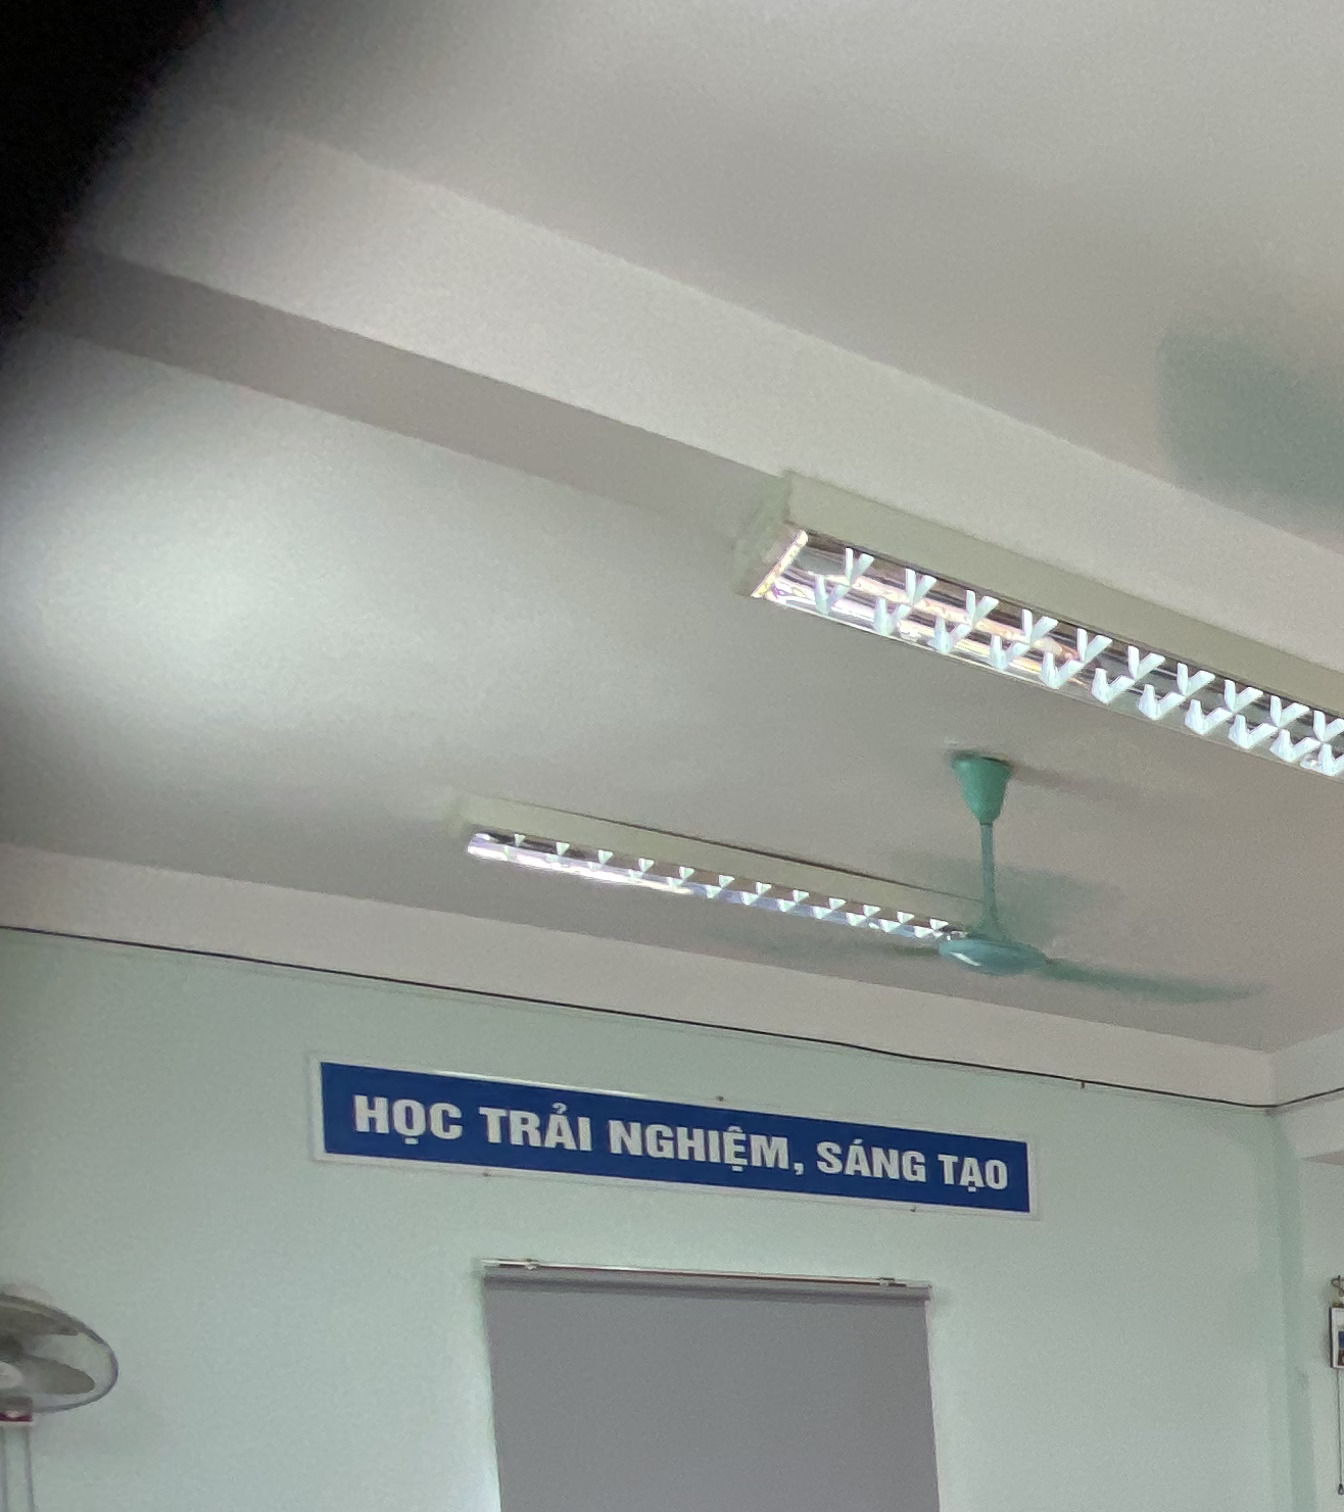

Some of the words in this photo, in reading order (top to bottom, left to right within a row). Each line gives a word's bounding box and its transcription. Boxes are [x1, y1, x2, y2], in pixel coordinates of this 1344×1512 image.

[353, 1094, 464, 1145] HỌC
[478, 1101, 592, 1152] TRẢI
[608, 1118, 804, 1175] NGHIỆM,
[816, 1138, 926, 1182] SÁNG
[940, 1156, 1009, 1194] TẠO
